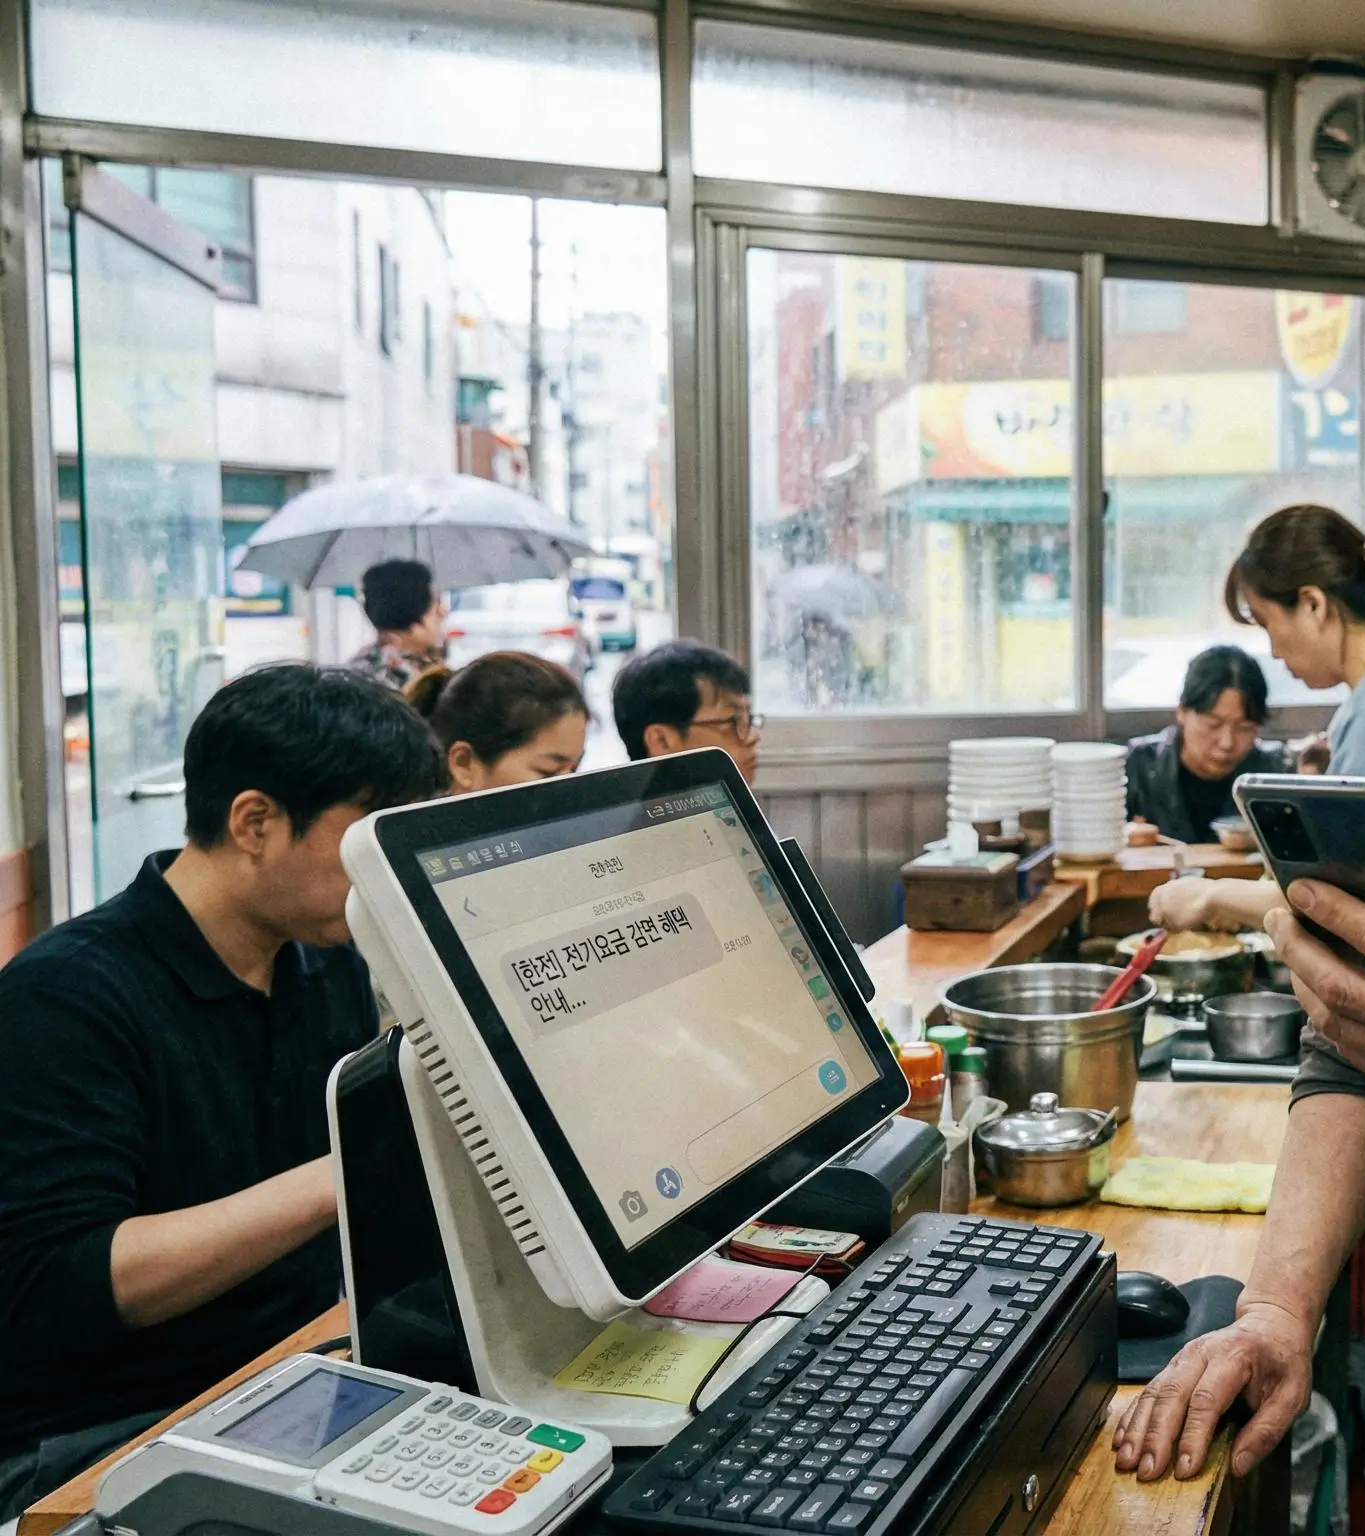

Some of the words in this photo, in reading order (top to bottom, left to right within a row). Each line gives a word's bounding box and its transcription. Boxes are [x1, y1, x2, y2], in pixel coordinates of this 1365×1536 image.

[511, 950, 567, 992] [한전]
[562, 928, 630, 972] 전기요금
[626, 916, 663, 949] 감면
[531, 987, 587, 1023] 안내...
